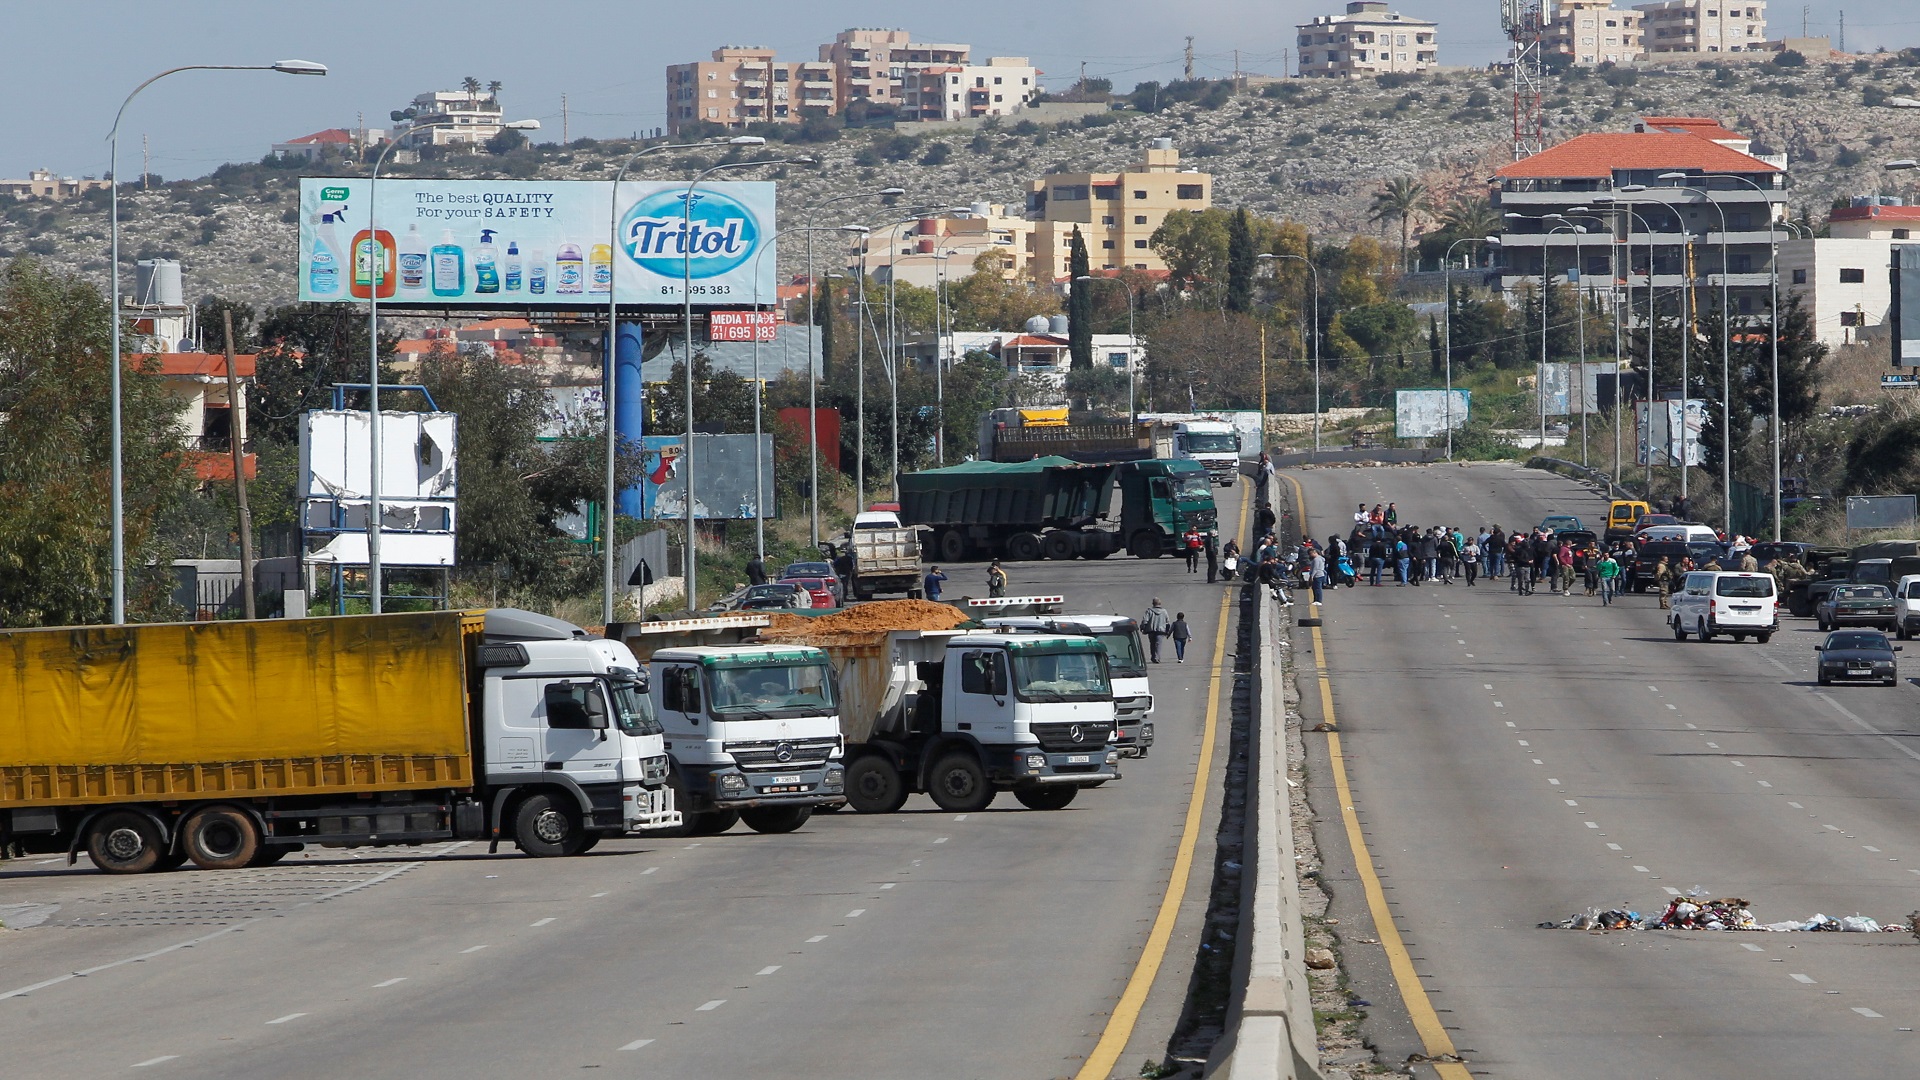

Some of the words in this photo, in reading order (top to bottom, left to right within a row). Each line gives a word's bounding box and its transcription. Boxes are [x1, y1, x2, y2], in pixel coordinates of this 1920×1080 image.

[415, 192, 444, 204] The
[448, 192, 480, 204] best
[483, 193, 554, 205] QUALITY
[416, 207, 442, 218] For
[445, 208, 481, 220] your
[485, 207, 554, 218] SAFETY
[630, 220, 741, 254] Tritol
[661, 285, 674, 295] 81
[709, 285, 731, 295] 383
[711, 314, 742, 325] MEDIA
[729, 326, 751, 339] 695
